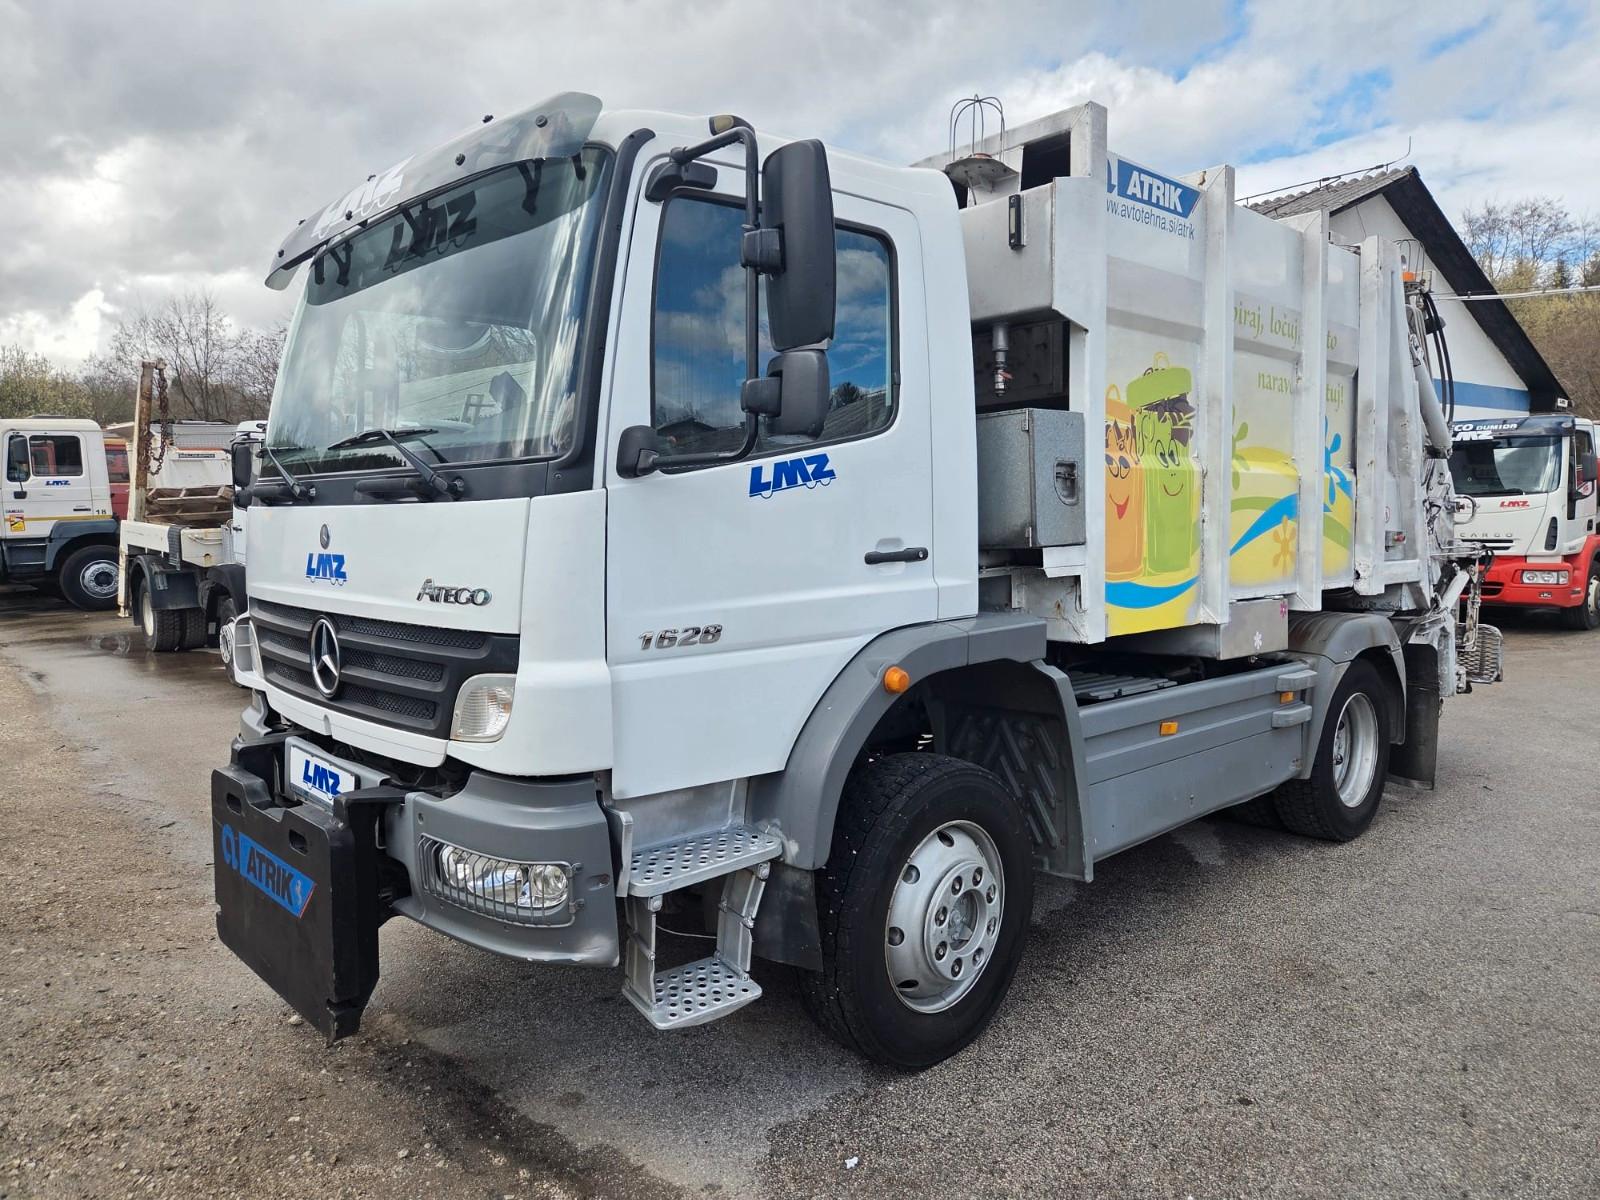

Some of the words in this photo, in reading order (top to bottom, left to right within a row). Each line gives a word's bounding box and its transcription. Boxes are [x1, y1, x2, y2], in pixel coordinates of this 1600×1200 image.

[1126, 170, 1183, 213] ATRIK
[749, 453, 838, 499] LMZ
[1500, 500, 1530, 508] LMZ
[305, 552, 347, 586] LMZ
[638, 623, 723, 650] 1628
[303, 759, 341, 797] LMZ
[246, 846, 294, 907] ATRIK
